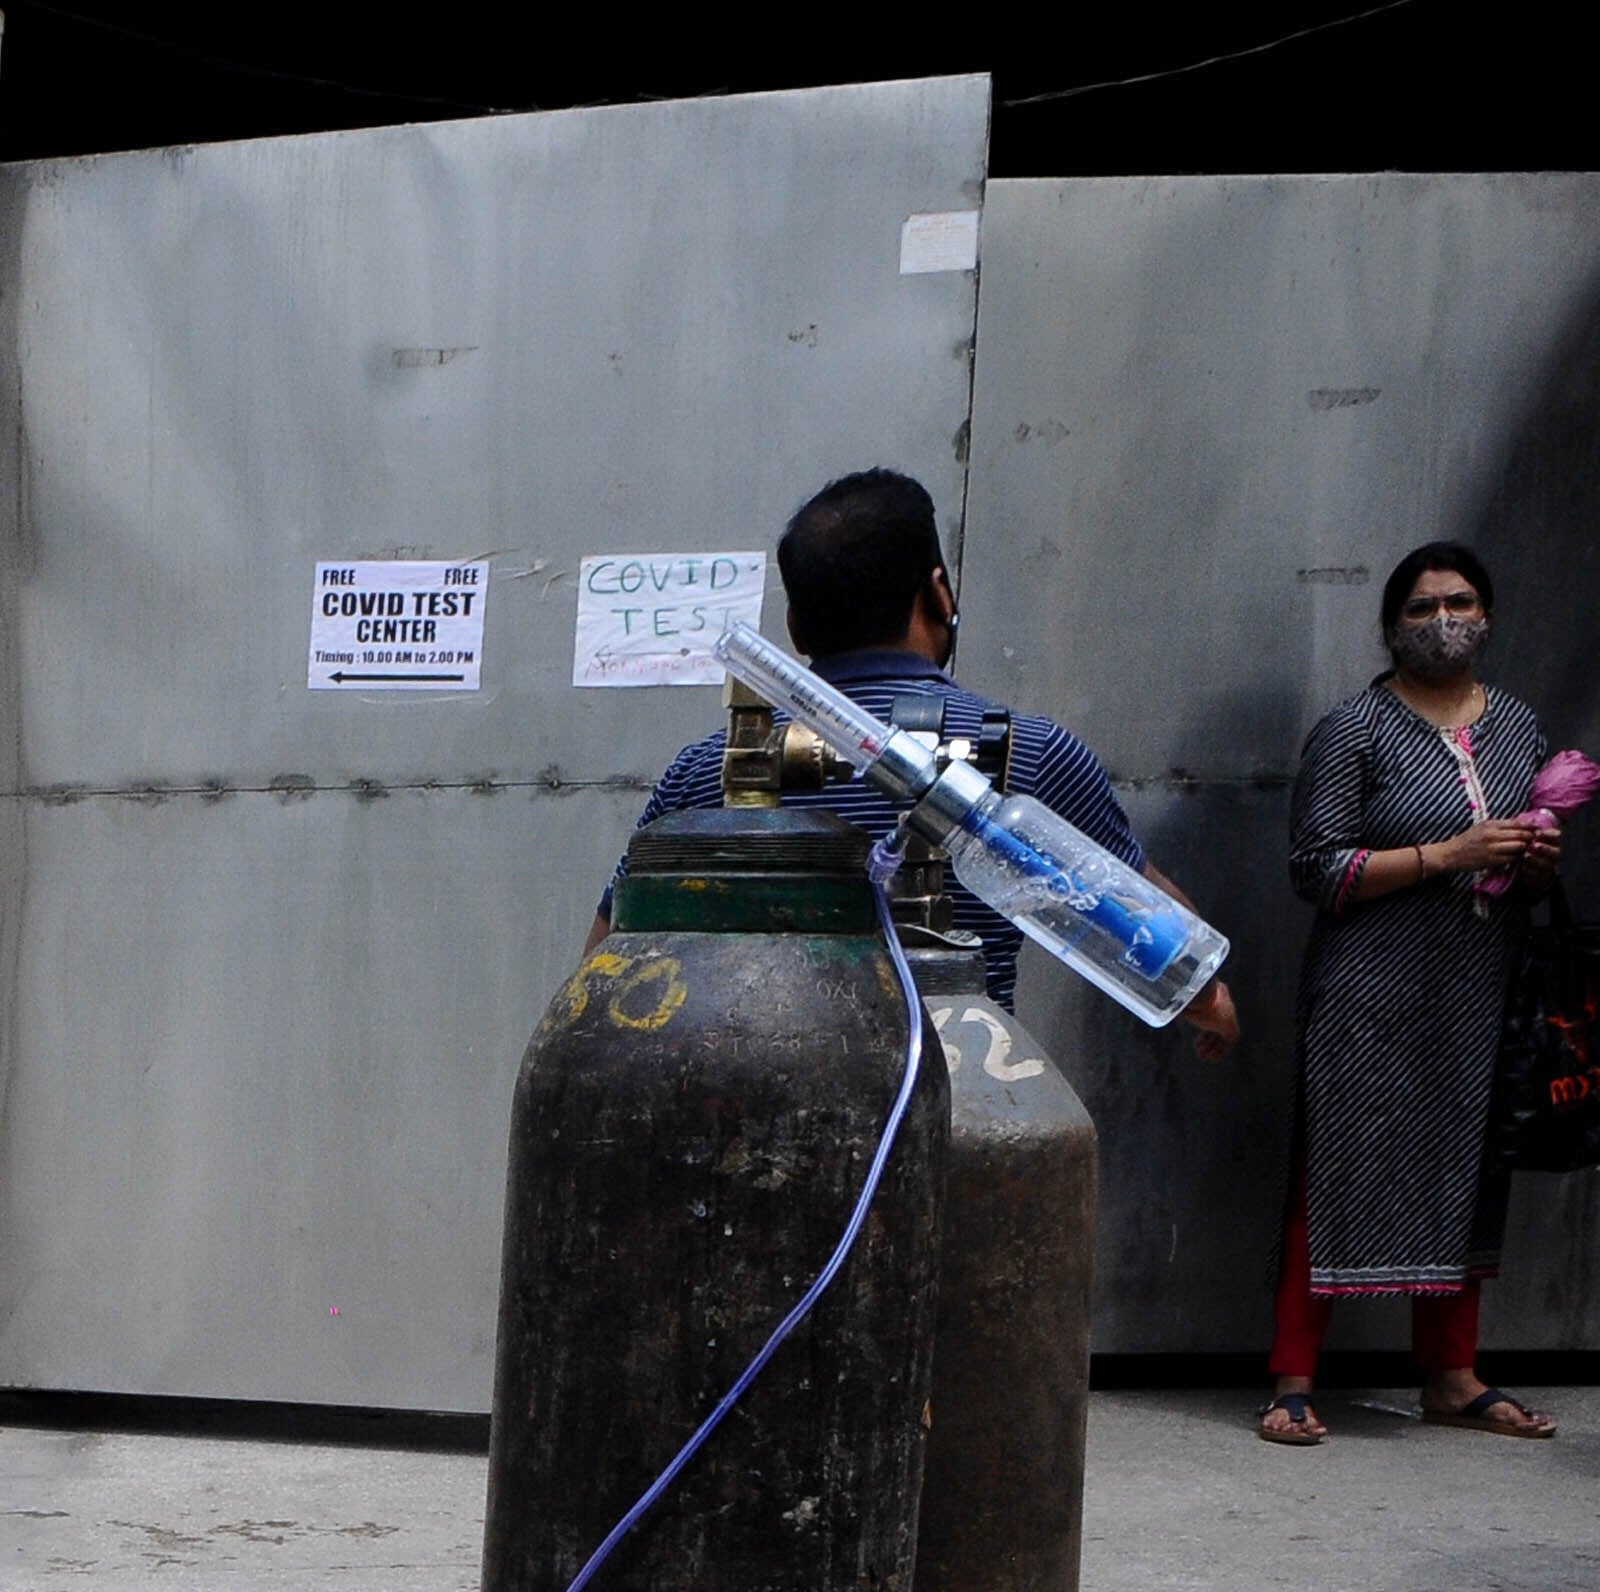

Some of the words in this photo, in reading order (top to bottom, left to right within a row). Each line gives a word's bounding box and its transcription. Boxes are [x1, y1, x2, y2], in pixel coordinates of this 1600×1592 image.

[322, 569, 356, 586] FREE
[444, 568, 479, 586] FREE
[587, 557, 739, 595] COVID
[322, 591, 405, 617] COVID
[412, 591, 476, 617] TEST
[356, 618, 437, 644] CENTER
[610, 606, 739, 637] TEST
[315, 650, 355, 665] Timing
[362, 650, 393, 664] 10.00
[395, 650, 412, 664] AM
[414, 650, 426, 664] to
[428, 650, 454, 664] 2.00
[456, 650, 474, 664] PM
